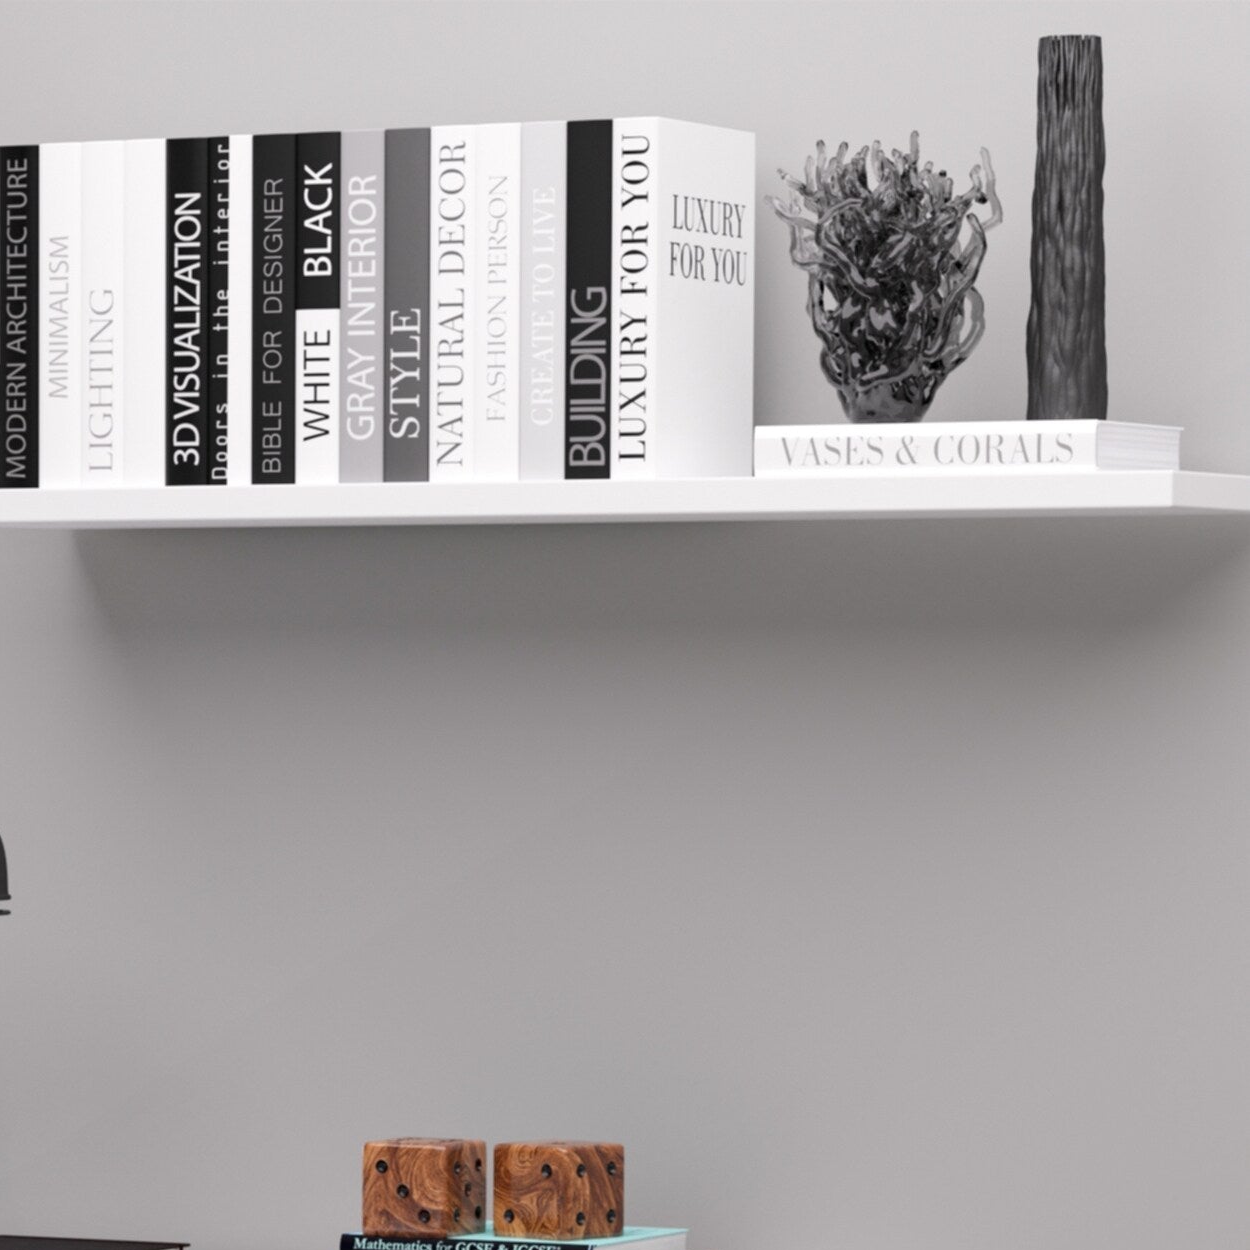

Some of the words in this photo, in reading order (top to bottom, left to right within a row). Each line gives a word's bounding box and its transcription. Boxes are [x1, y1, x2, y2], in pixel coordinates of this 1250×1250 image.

[213, 144, 230, 265] interior
[303, 162, 333, 277] BLACK
[439, 140, 466, 274] DECOR
[532, 186, 556, 253] LIVE
[621, 134, 650, 209] YOU
[672, 193, 747, 239] LUXURY
[6, 157, 28, 355] ARCHITECTURE
[263, 177, 283, 314] DESIGNER
[348, 174, 377, 336] INTERIOR
[487, 175, 509, 285] PERSON
[532, 262, 555, 302] TO
[620, 221, 649, 296] FOR
[669, 241, 706, 282] FOR
[713, 248, 748, 286] YOU
[48, 235, 69, 399] MINIMALISM
[174, 192, 202, 421] VISUALIZATION
[213, 288, 229, 331] the
[262, 330, 282, 384] FOR
[486, 295, 506, 422] FASHION
[6, 362, 27, 479] MODERN
[88, 288, 114, 472] LIGHTING
[212, 352, 229, 379] in
[303, 329, 331, 442] WHITE
[347, 350, 376, 440] GRAY
[389, 308, 421, 439] STYLE
[436, 288, 464, 467] NATURAL
[530, 310, 555, 426] CREATE
[569, 286, 607, 467] BUILDING
[618, 311, 648, 462] LUXURY
[173, 424, 200, 467] 3D
[212, 402, 228, 480] Doors
[262, 400, 282, 474] BIBLE
[780, 436, 884, 467] VASES
[895, 438, 919, 466] &
[933, 432, 1075, 467] CORALS
